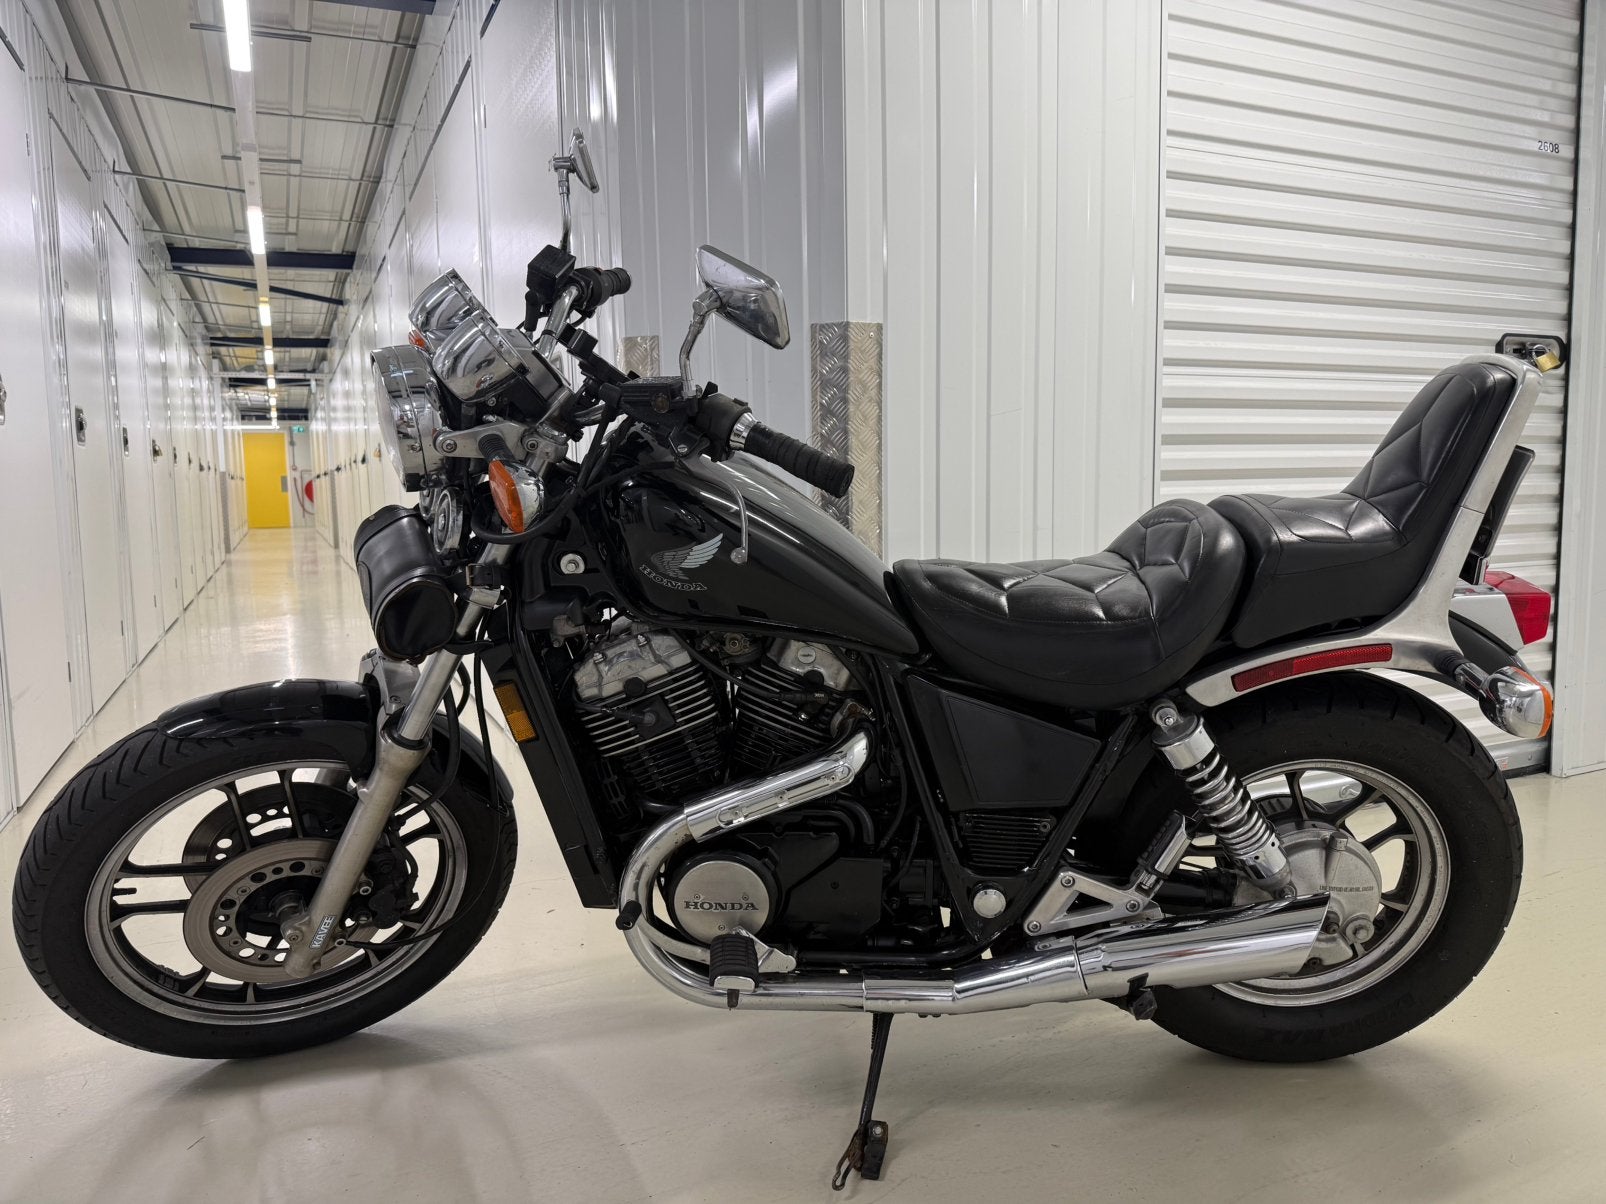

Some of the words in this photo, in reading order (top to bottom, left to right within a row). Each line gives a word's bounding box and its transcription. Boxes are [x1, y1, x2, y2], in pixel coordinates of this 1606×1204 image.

[1537, 140, 1560, 154] 2608
[639, 564, 708, 591] HONDA
[683, 900, 759, 911] HONDA
[311, 915, 335, 948] KAVEE
